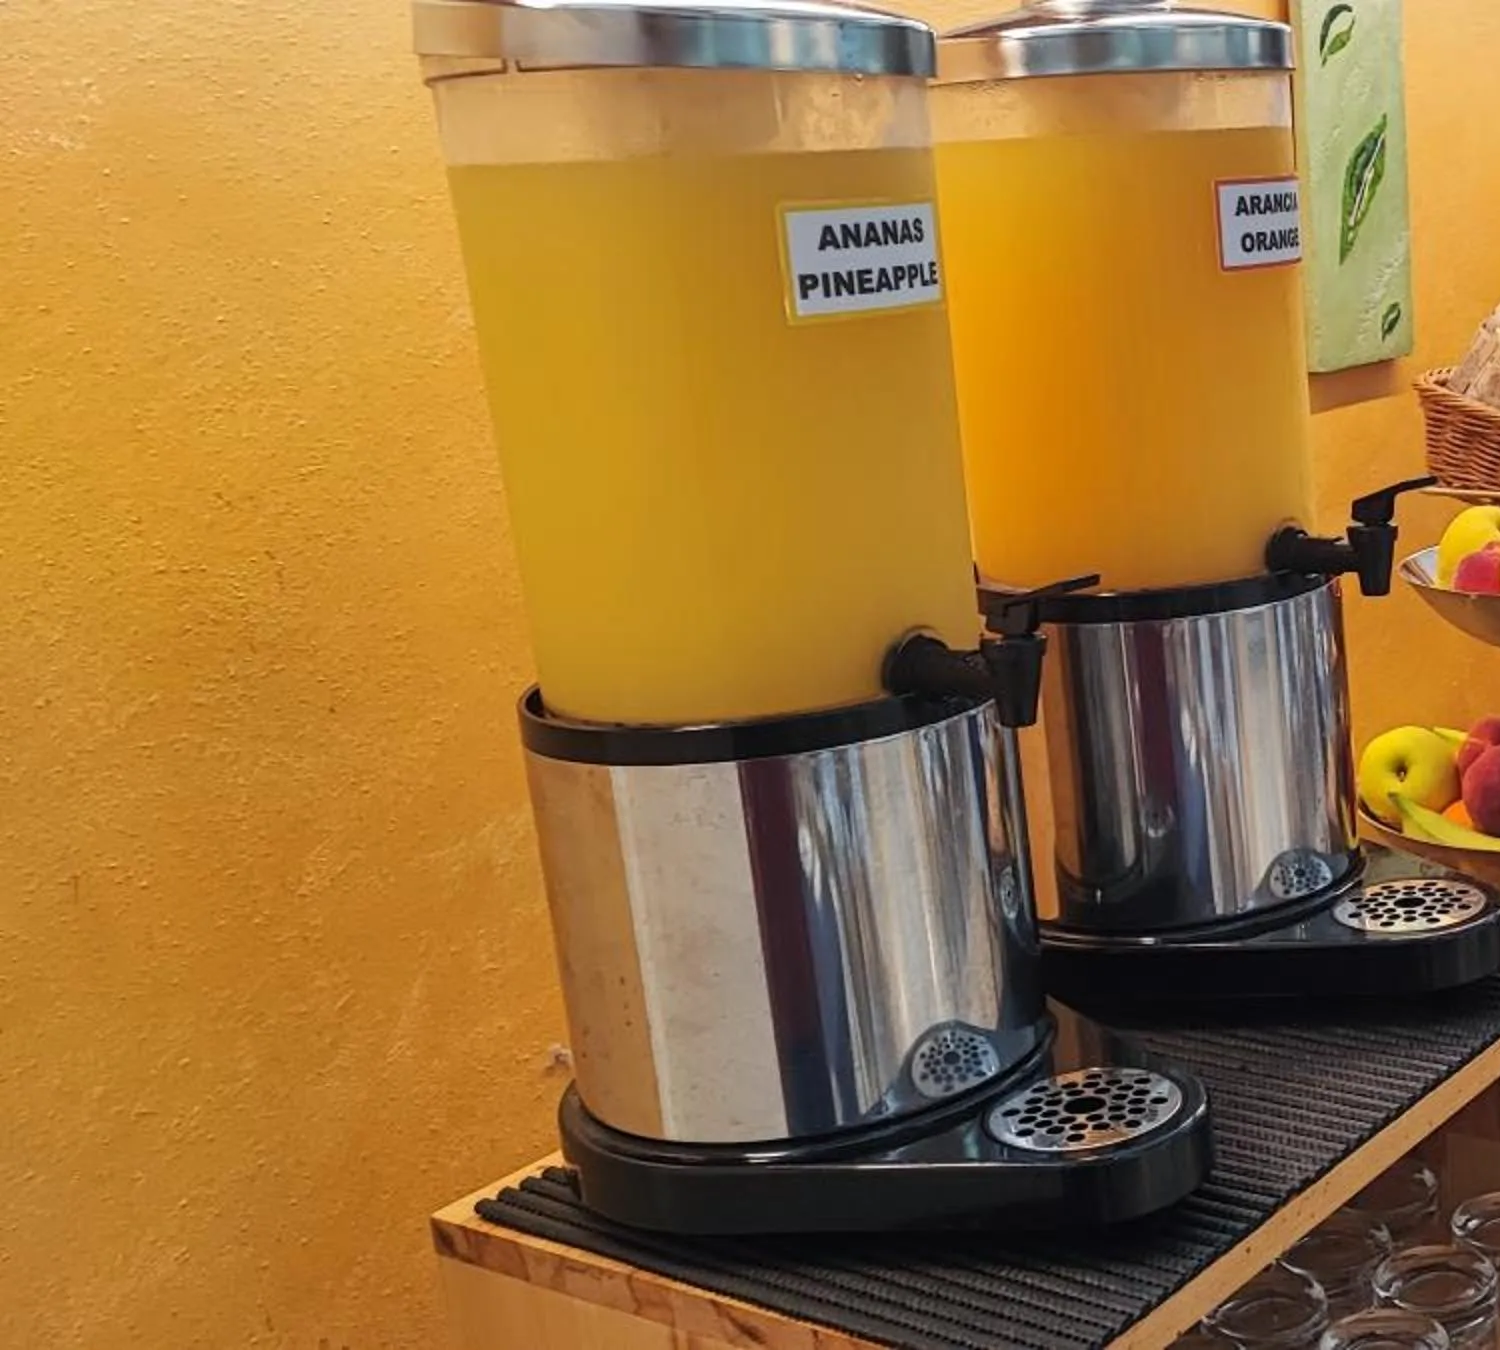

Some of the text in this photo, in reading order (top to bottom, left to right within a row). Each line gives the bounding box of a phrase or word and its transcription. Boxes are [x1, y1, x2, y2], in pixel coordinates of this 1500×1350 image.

[817, 217, 925, 251] ANANAS
[1241, 227, 1299, 253] ORANGE
[798, 261, 938, 300] PINEAPPLE
